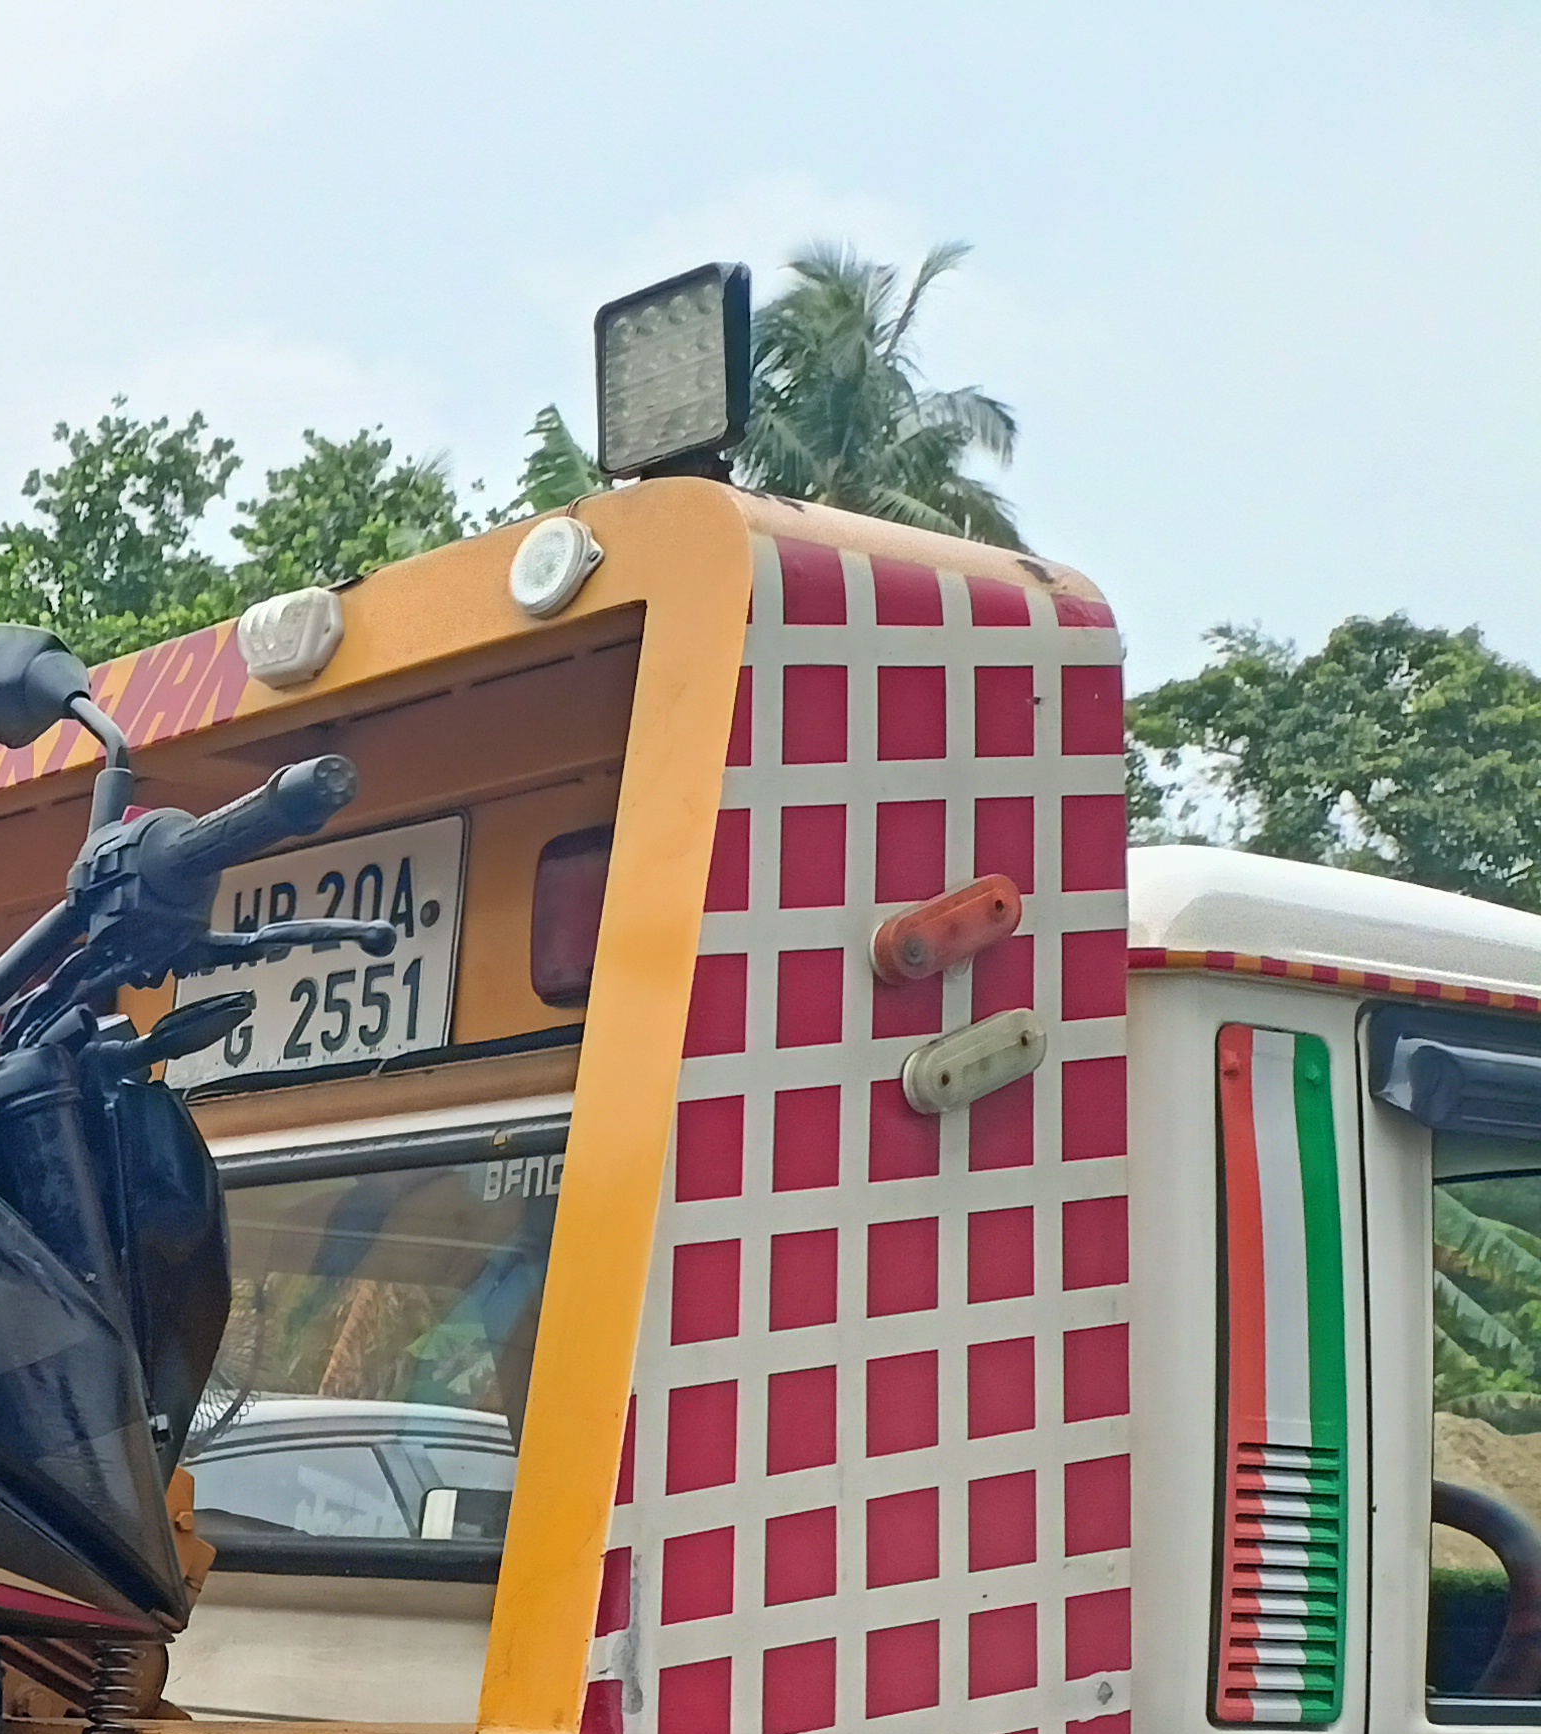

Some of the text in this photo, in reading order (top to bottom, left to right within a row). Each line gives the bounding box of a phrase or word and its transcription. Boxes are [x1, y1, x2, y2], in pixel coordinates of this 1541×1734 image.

[118, 622, 250, 753] VAN
[232, 857, 415, 971] WB 20A
[282, 957, 422, 1060] 2551
